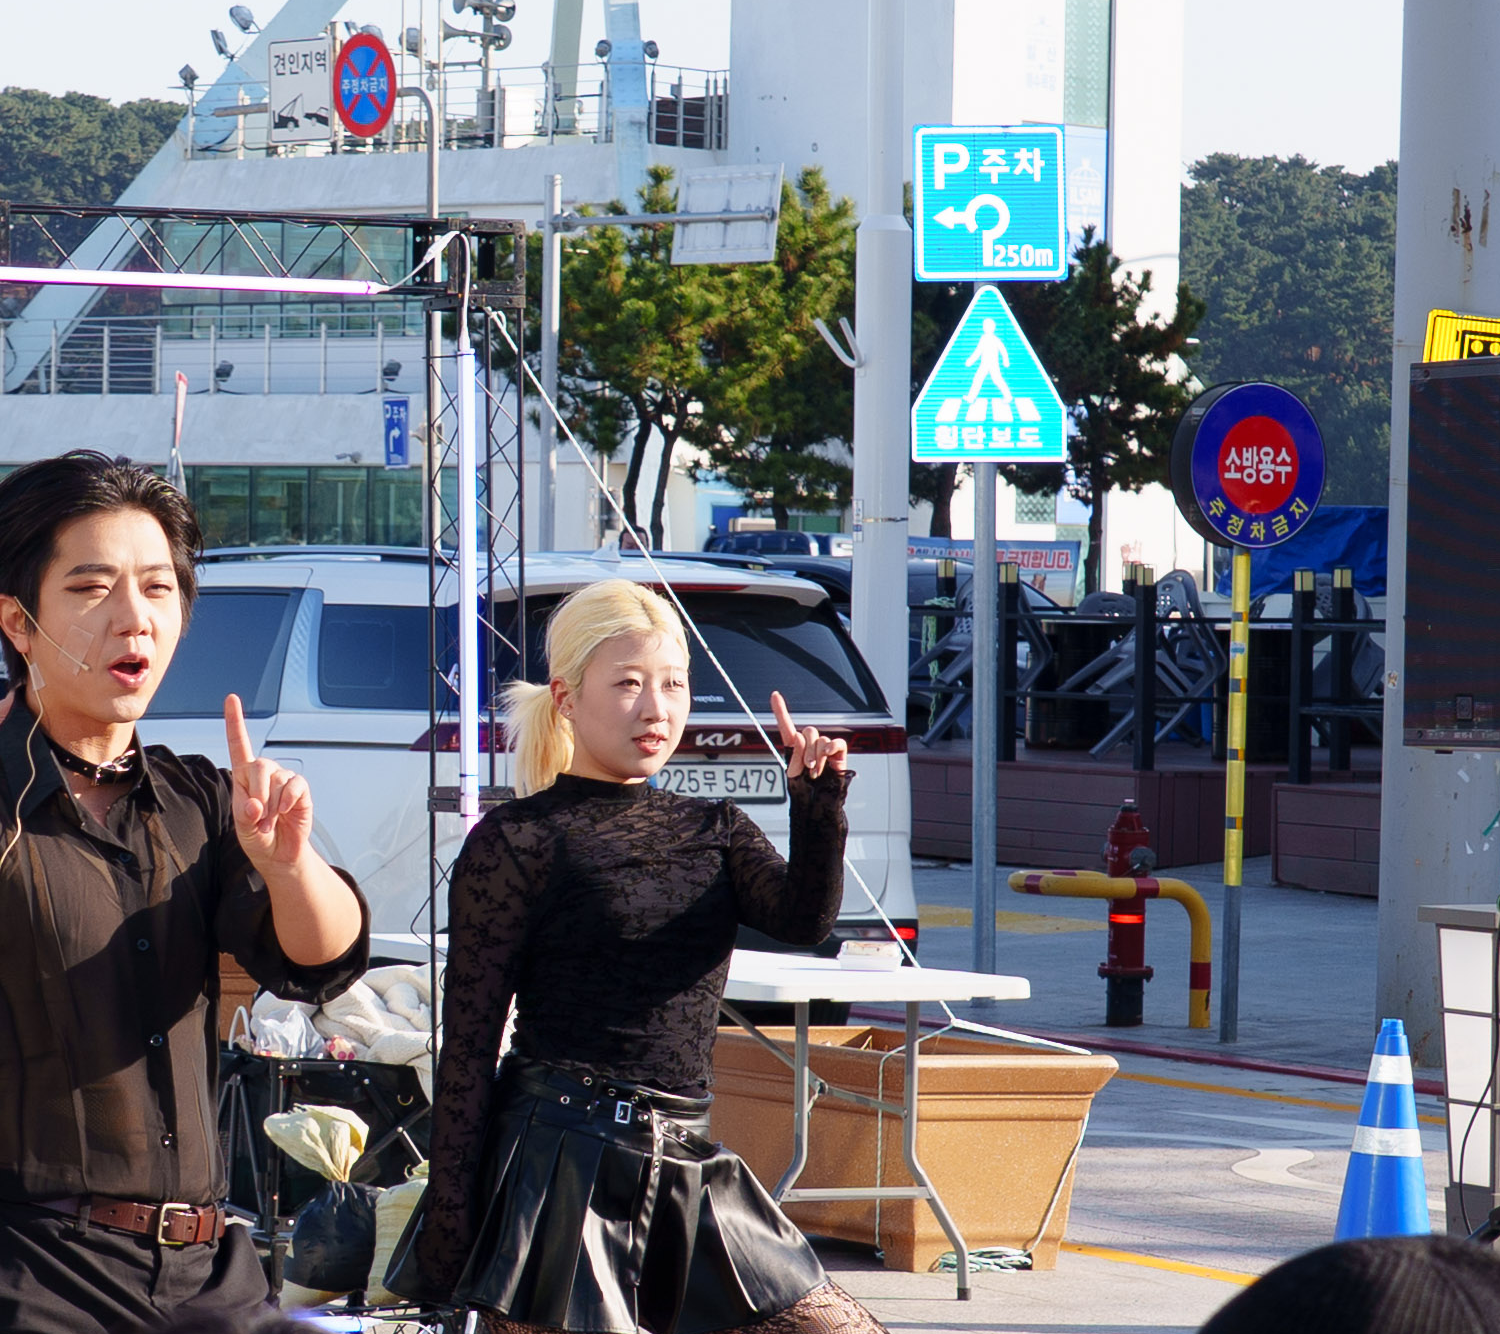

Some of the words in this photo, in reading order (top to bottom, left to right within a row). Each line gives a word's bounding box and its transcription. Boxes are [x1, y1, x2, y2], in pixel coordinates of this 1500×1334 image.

[273, 49, 327, 76] 견인지역
[342, 77, 387, 94] 주정차금지
[933, 143, 970, 190] P
[979, 147, 1045, 184] 주차
[993, 244, 1054, 268] 250m
[934, 425, 1044, 450] 횡단보도
[1224, 445, 1292, 484] 소방용수
[1208, 497, 1309, 541] 주정차금지
[724, 769, 777, 794] 5479
